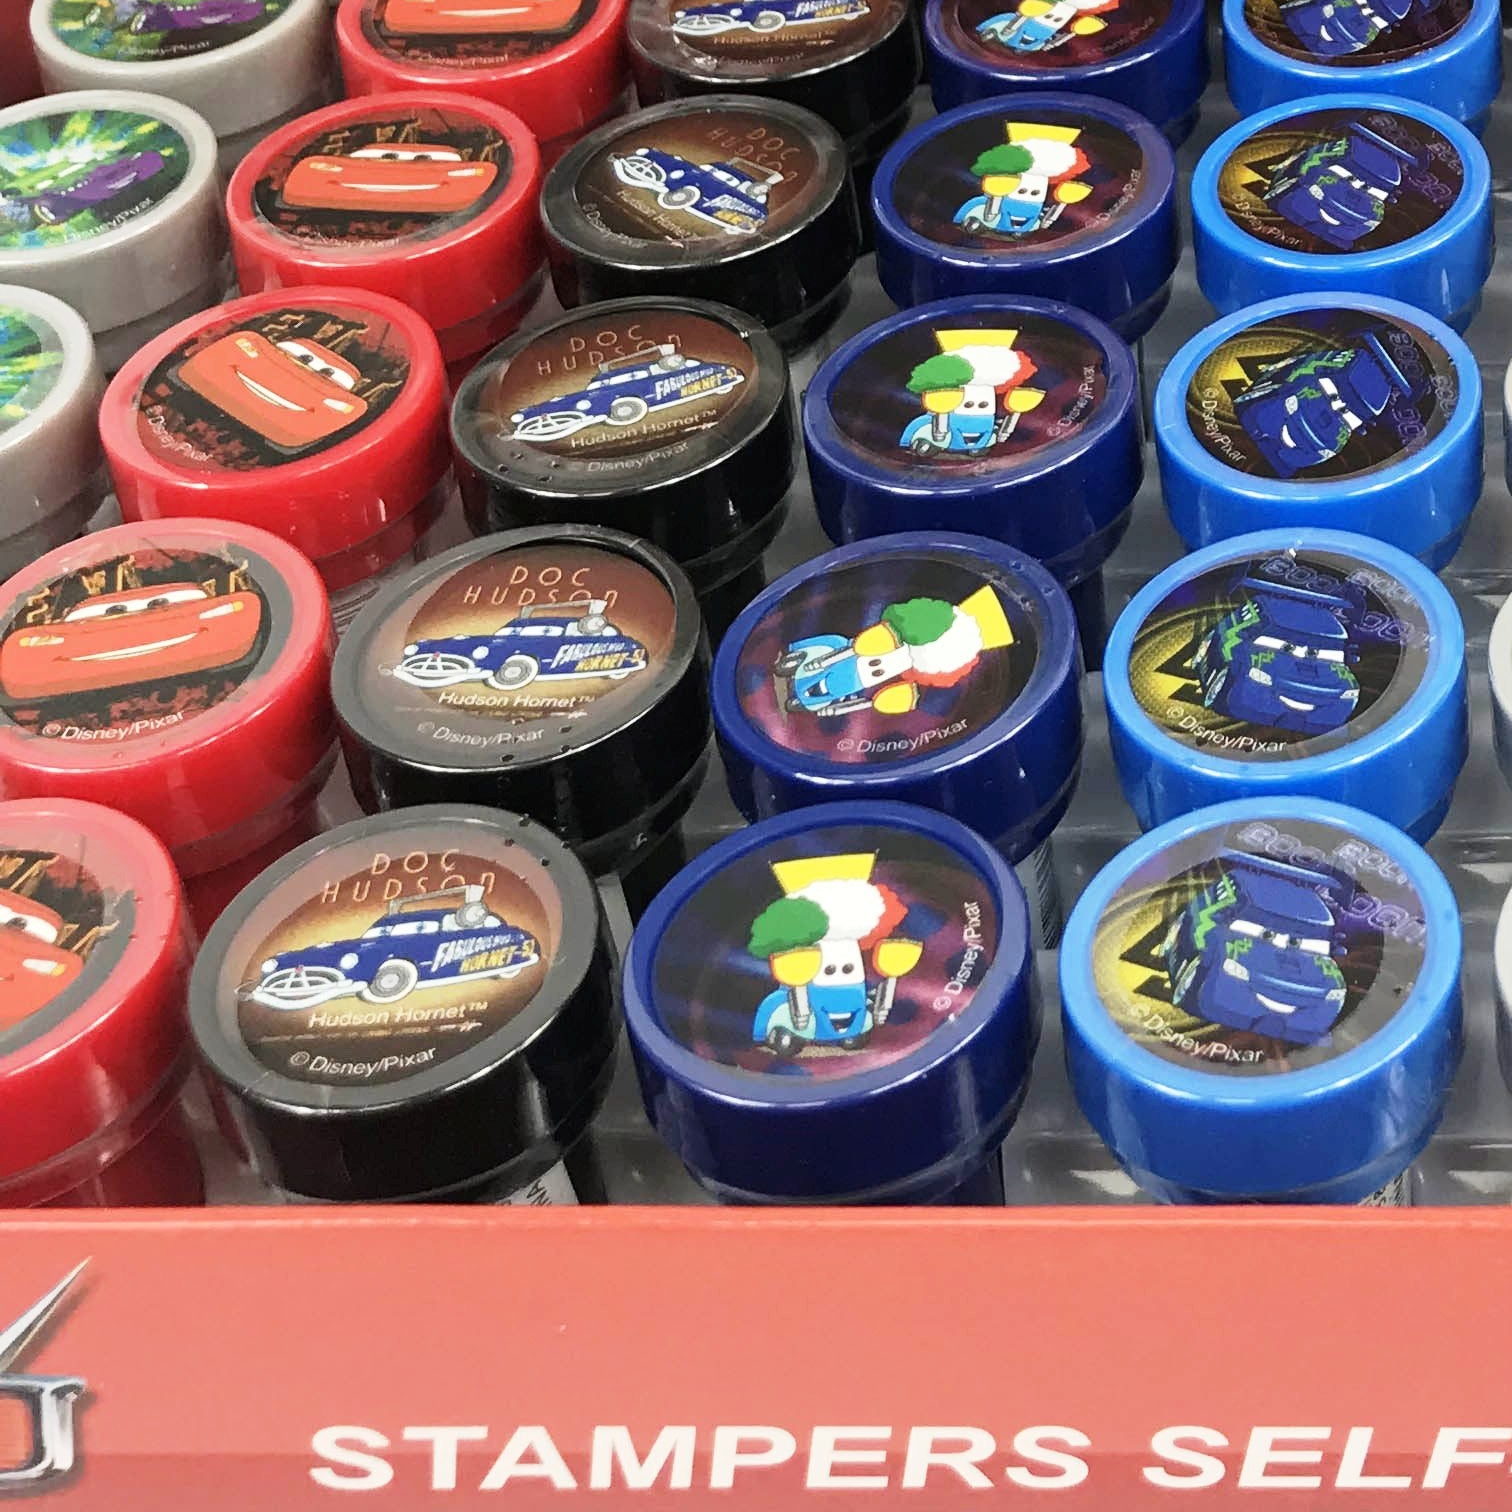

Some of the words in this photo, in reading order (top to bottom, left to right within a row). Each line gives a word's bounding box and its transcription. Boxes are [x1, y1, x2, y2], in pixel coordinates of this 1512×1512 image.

[569, 324, 644, 353] DOC
[510, 566, 591, 587] DOC
[438, 691, 510, 707] Hudson
[371, 848, 460, 875] DOC
[308, 1004, 390, 1029] Hudson
[309, 1425, 1091, 1490] STAMPERS
